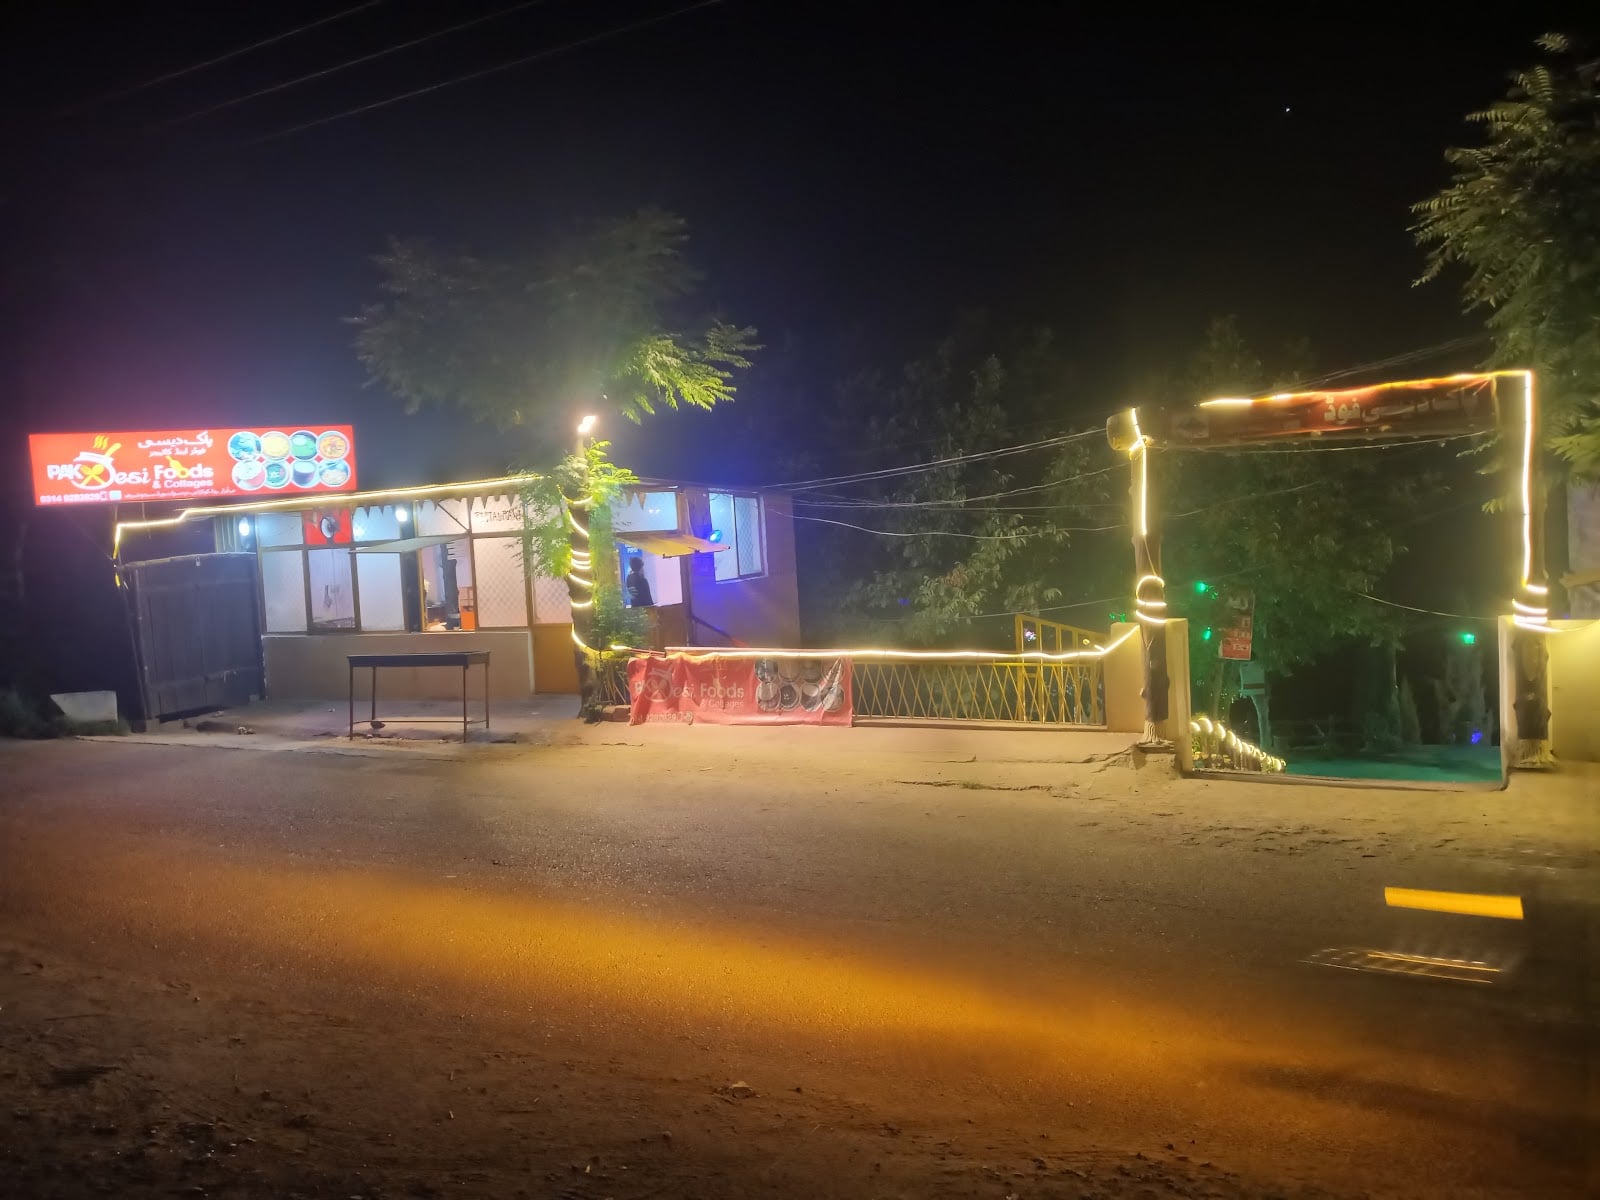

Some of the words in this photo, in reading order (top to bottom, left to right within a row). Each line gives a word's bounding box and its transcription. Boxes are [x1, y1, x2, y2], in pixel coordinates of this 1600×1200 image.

[46, 463, 84, 480] PAK
[153, 463, 214, 479] Foods
[152, 480, 162, 489] &
[700, 681, 745, 699] Foods
